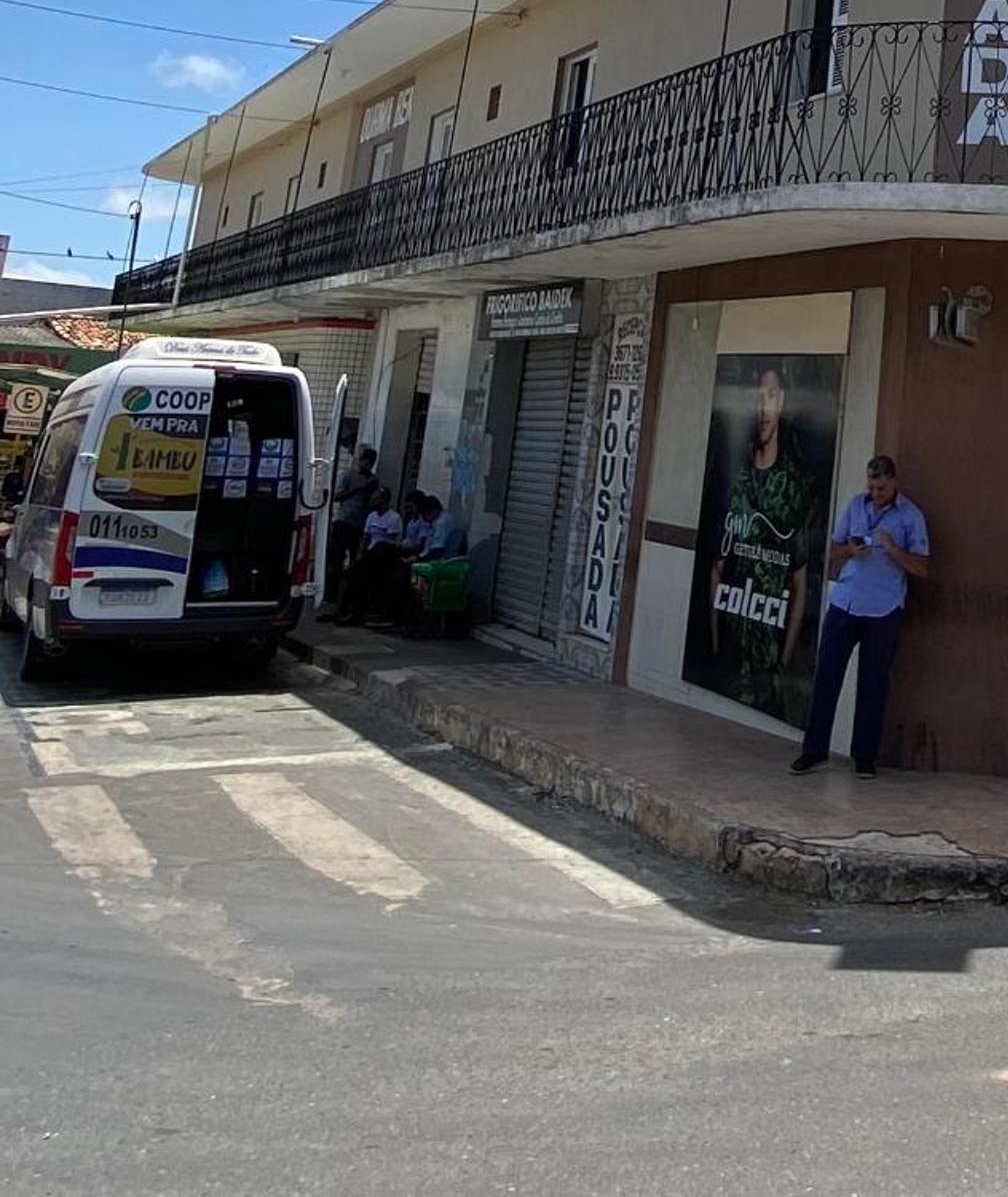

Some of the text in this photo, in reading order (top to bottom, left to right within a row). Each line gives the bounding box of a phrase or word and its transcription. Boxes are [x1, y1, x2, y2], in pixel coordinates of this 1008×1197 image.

[155, 390, 210, 411] COOP
[130, 417, 199, 433] VEM PRA
[132, 447, 198, 472] BAMBU
[584, 389, 622, 629] POUSADA
[713, 577, 791, 629] colcci
